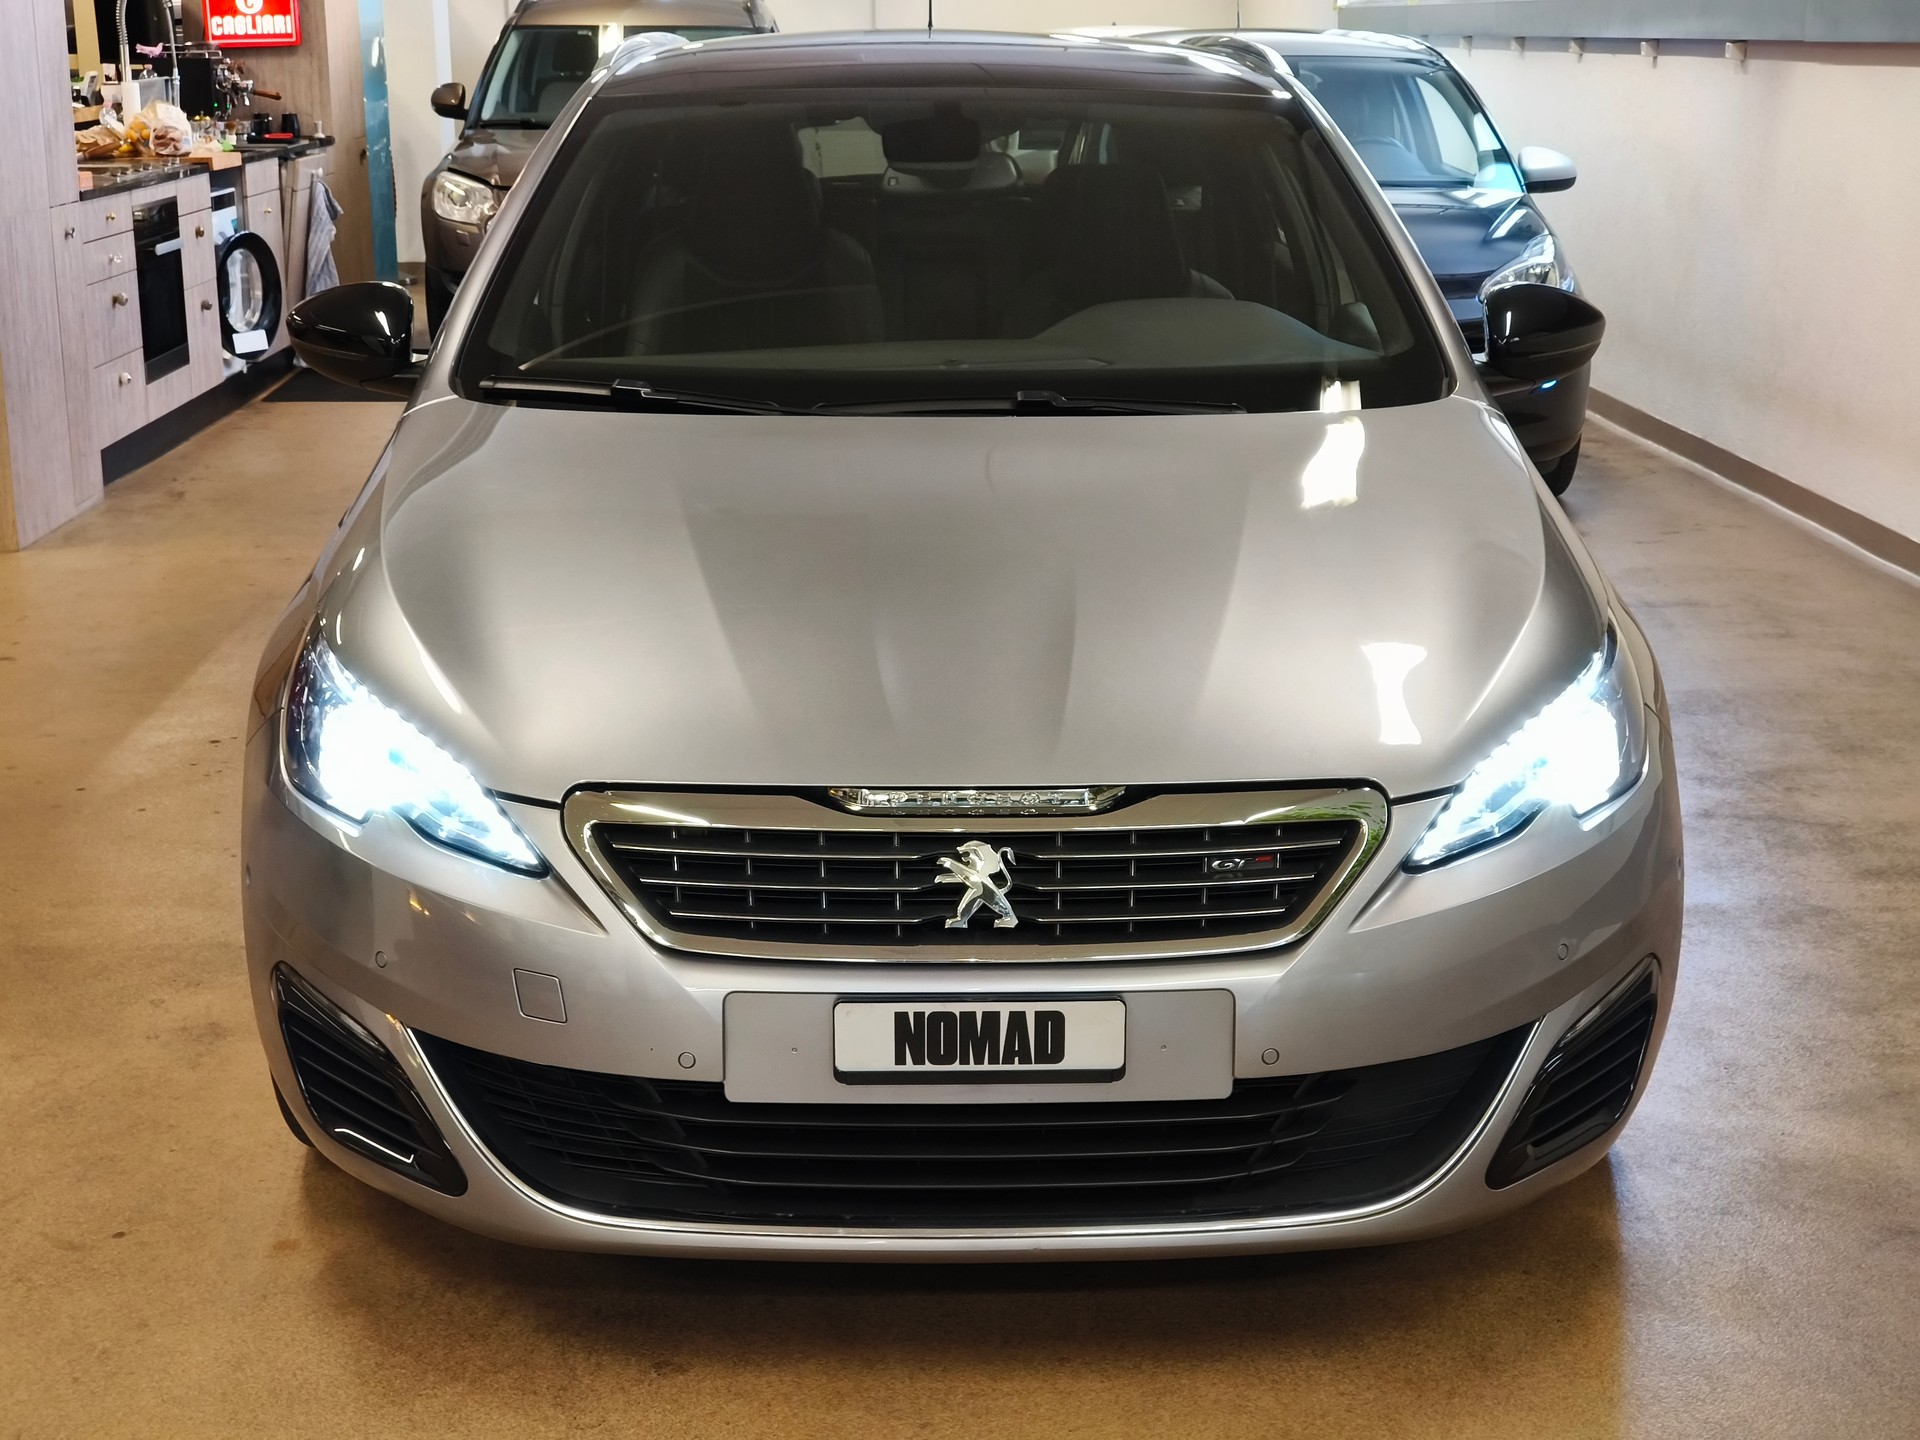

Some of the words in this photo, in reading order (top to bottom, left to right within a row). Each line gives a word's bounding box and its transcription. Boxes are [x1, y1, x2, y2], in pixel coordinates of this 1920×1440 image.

[211, 14, 292, 36] CAGLIARI
[1211, 857, 1248, 870] GT
[894, 1010, 1065, 1066] NOMAD
